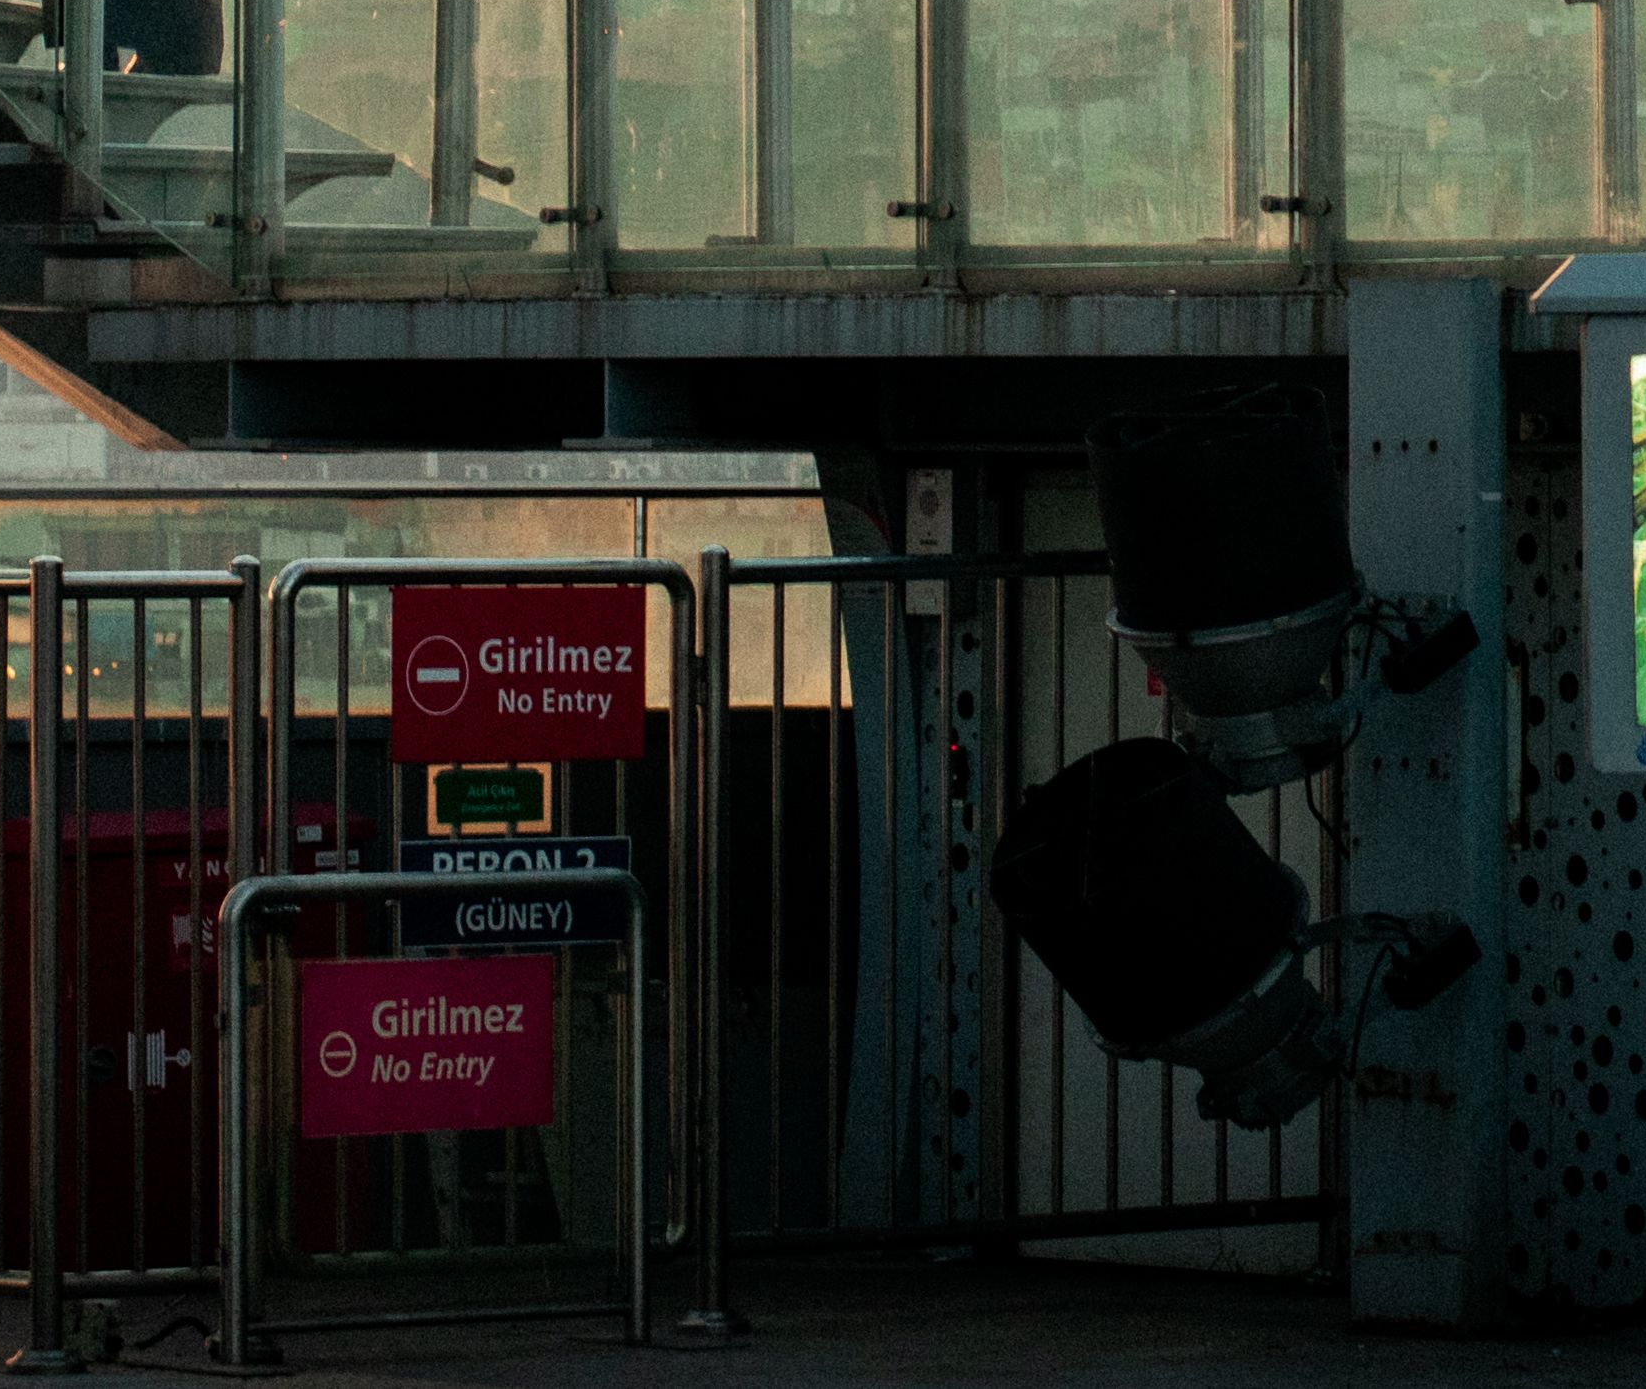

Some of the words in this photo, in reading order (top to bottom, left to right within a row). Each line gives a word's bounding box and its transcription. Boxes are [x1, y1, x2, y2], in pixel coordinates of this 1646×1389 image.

[479, 636, 632, 674] Girilmez
[498, 688, 533, 714] No
[543, 687, 612, 720] Entry
[455, 897, 574, 938] (GÜNEY)
[372, 996, 524, 1038] Girilmez
[370, 1054, 411, 1083] No
[419, 1051, 495, 1087] Entry
